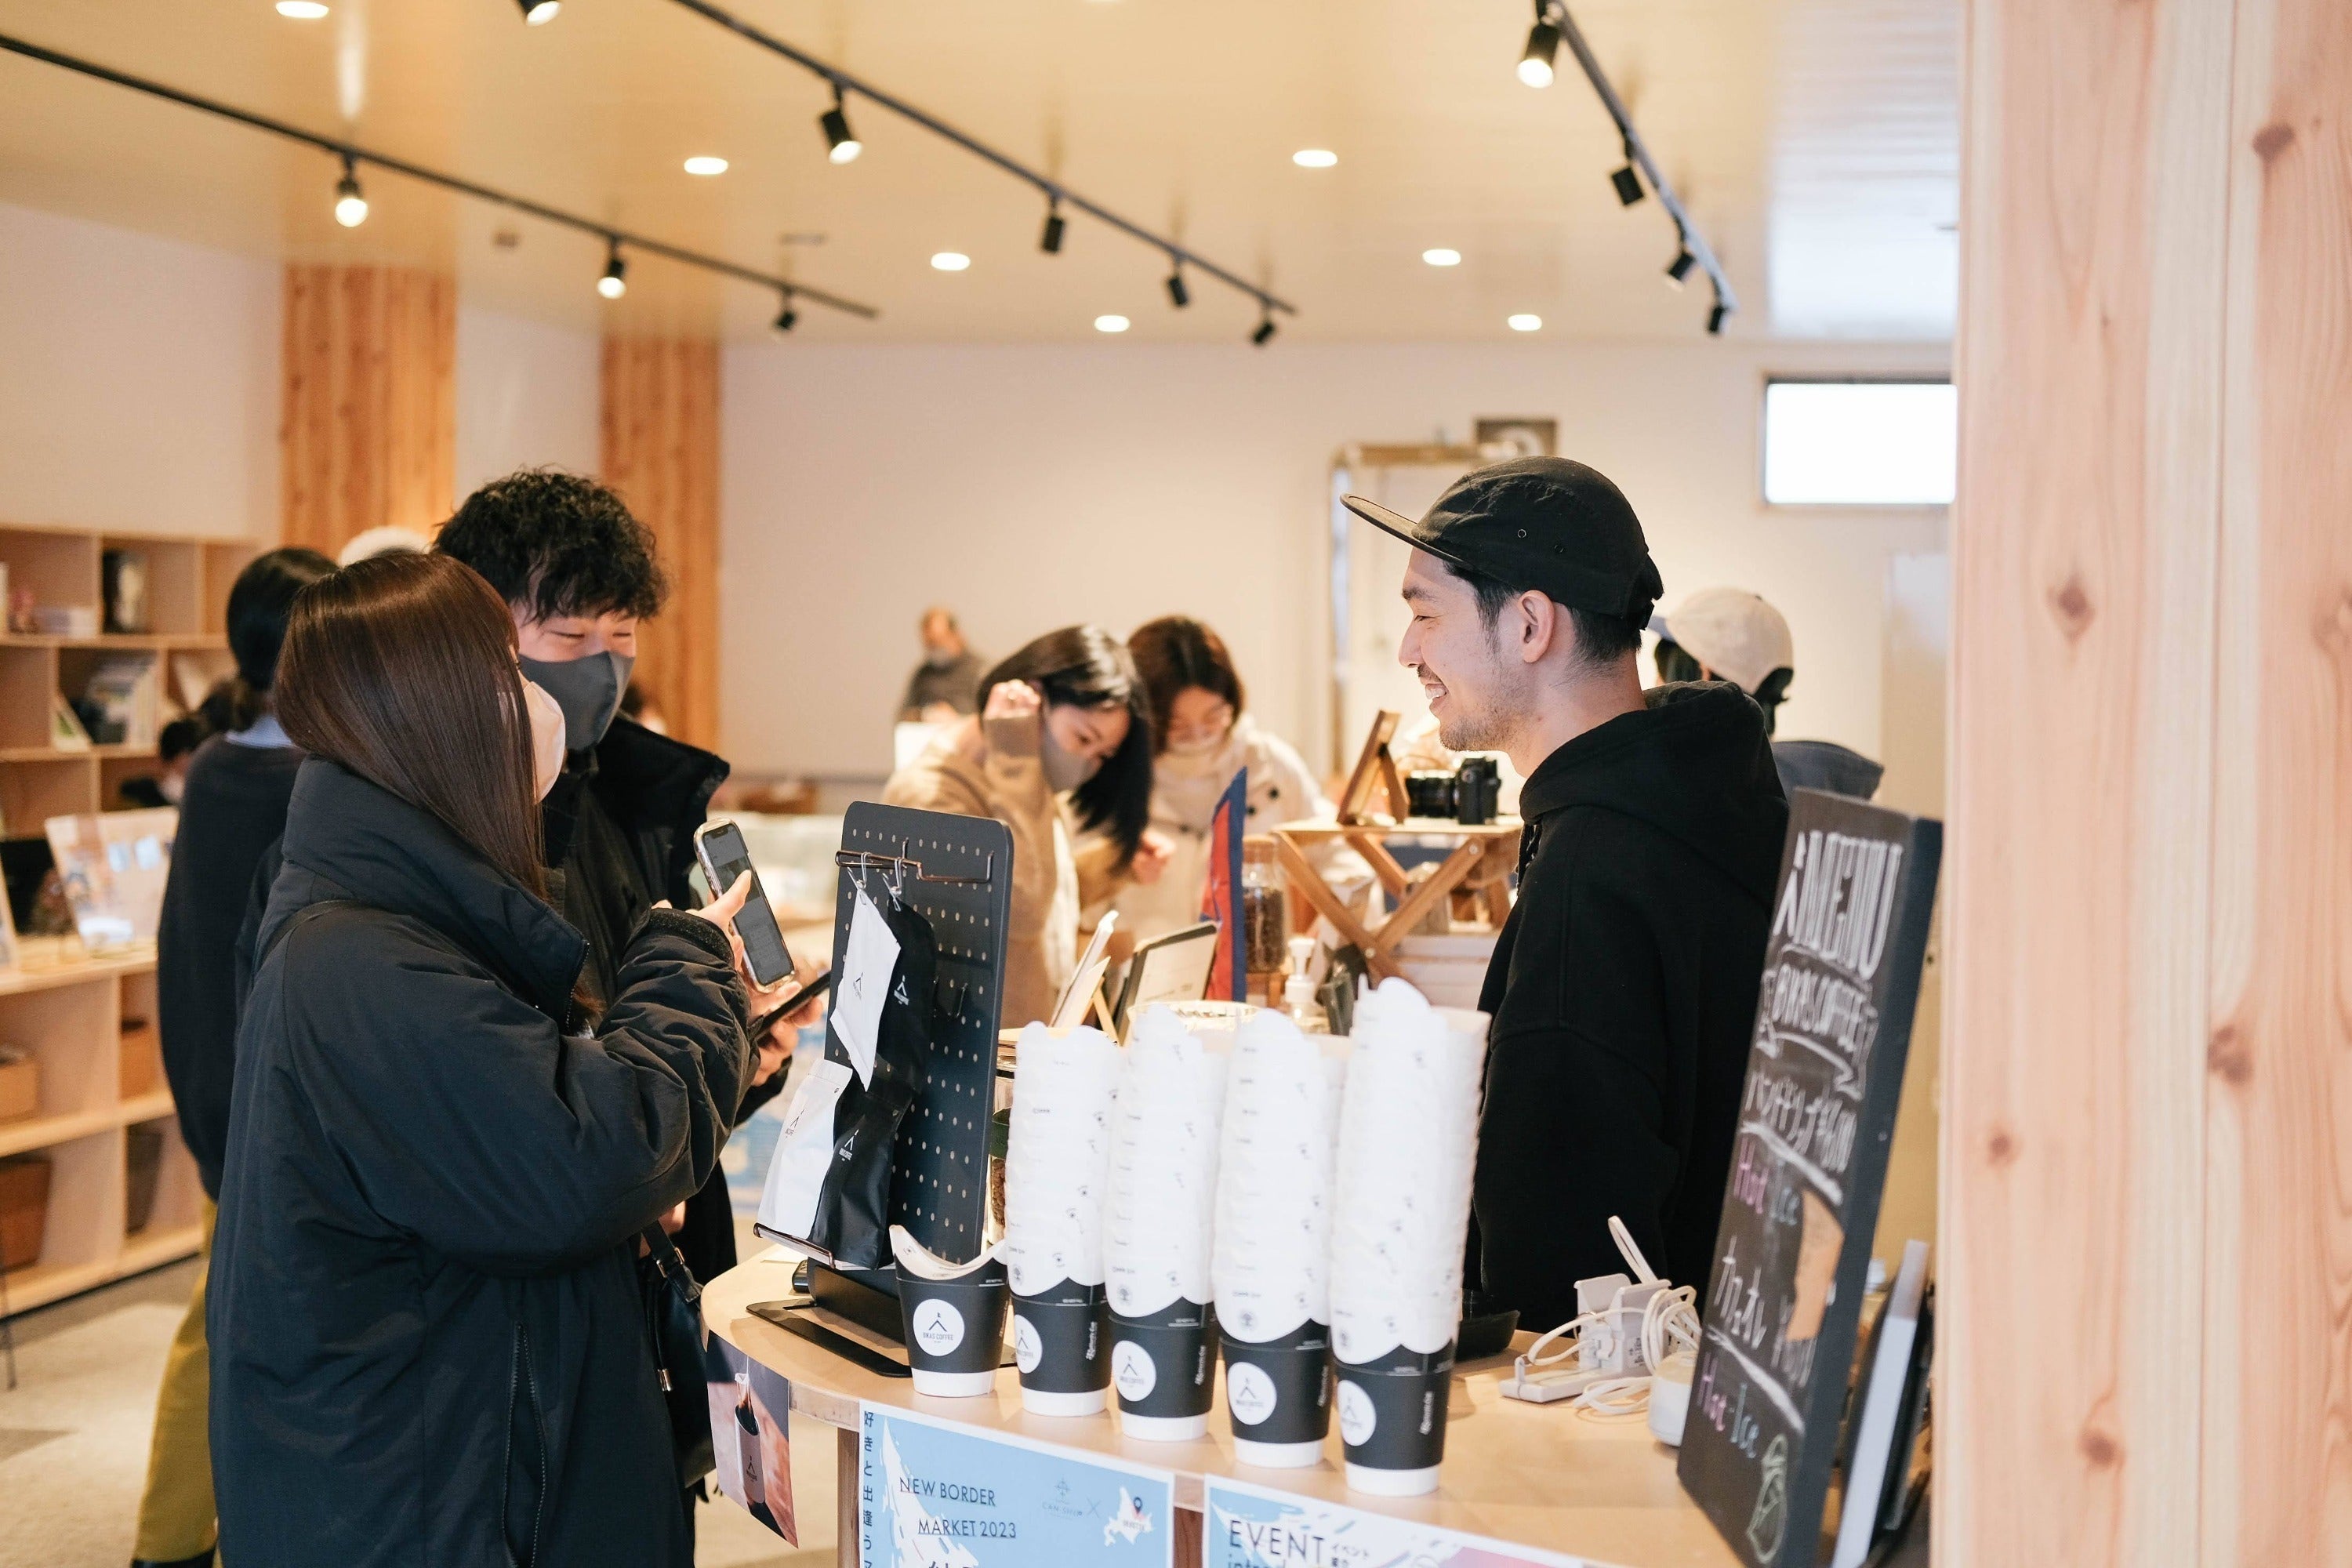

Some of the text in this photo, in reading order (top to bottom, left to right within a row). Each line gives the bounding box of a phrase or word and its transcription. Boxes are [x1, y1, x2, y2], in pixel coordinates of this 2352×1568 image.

[1792, 829, 1904, 981] MENU
[899, 1477, 996, 1507] NEW BORDER
[917, 1518, 1017, 1539] MARKET 2023
[1229, 1519, 1325, 1565] EVENT
